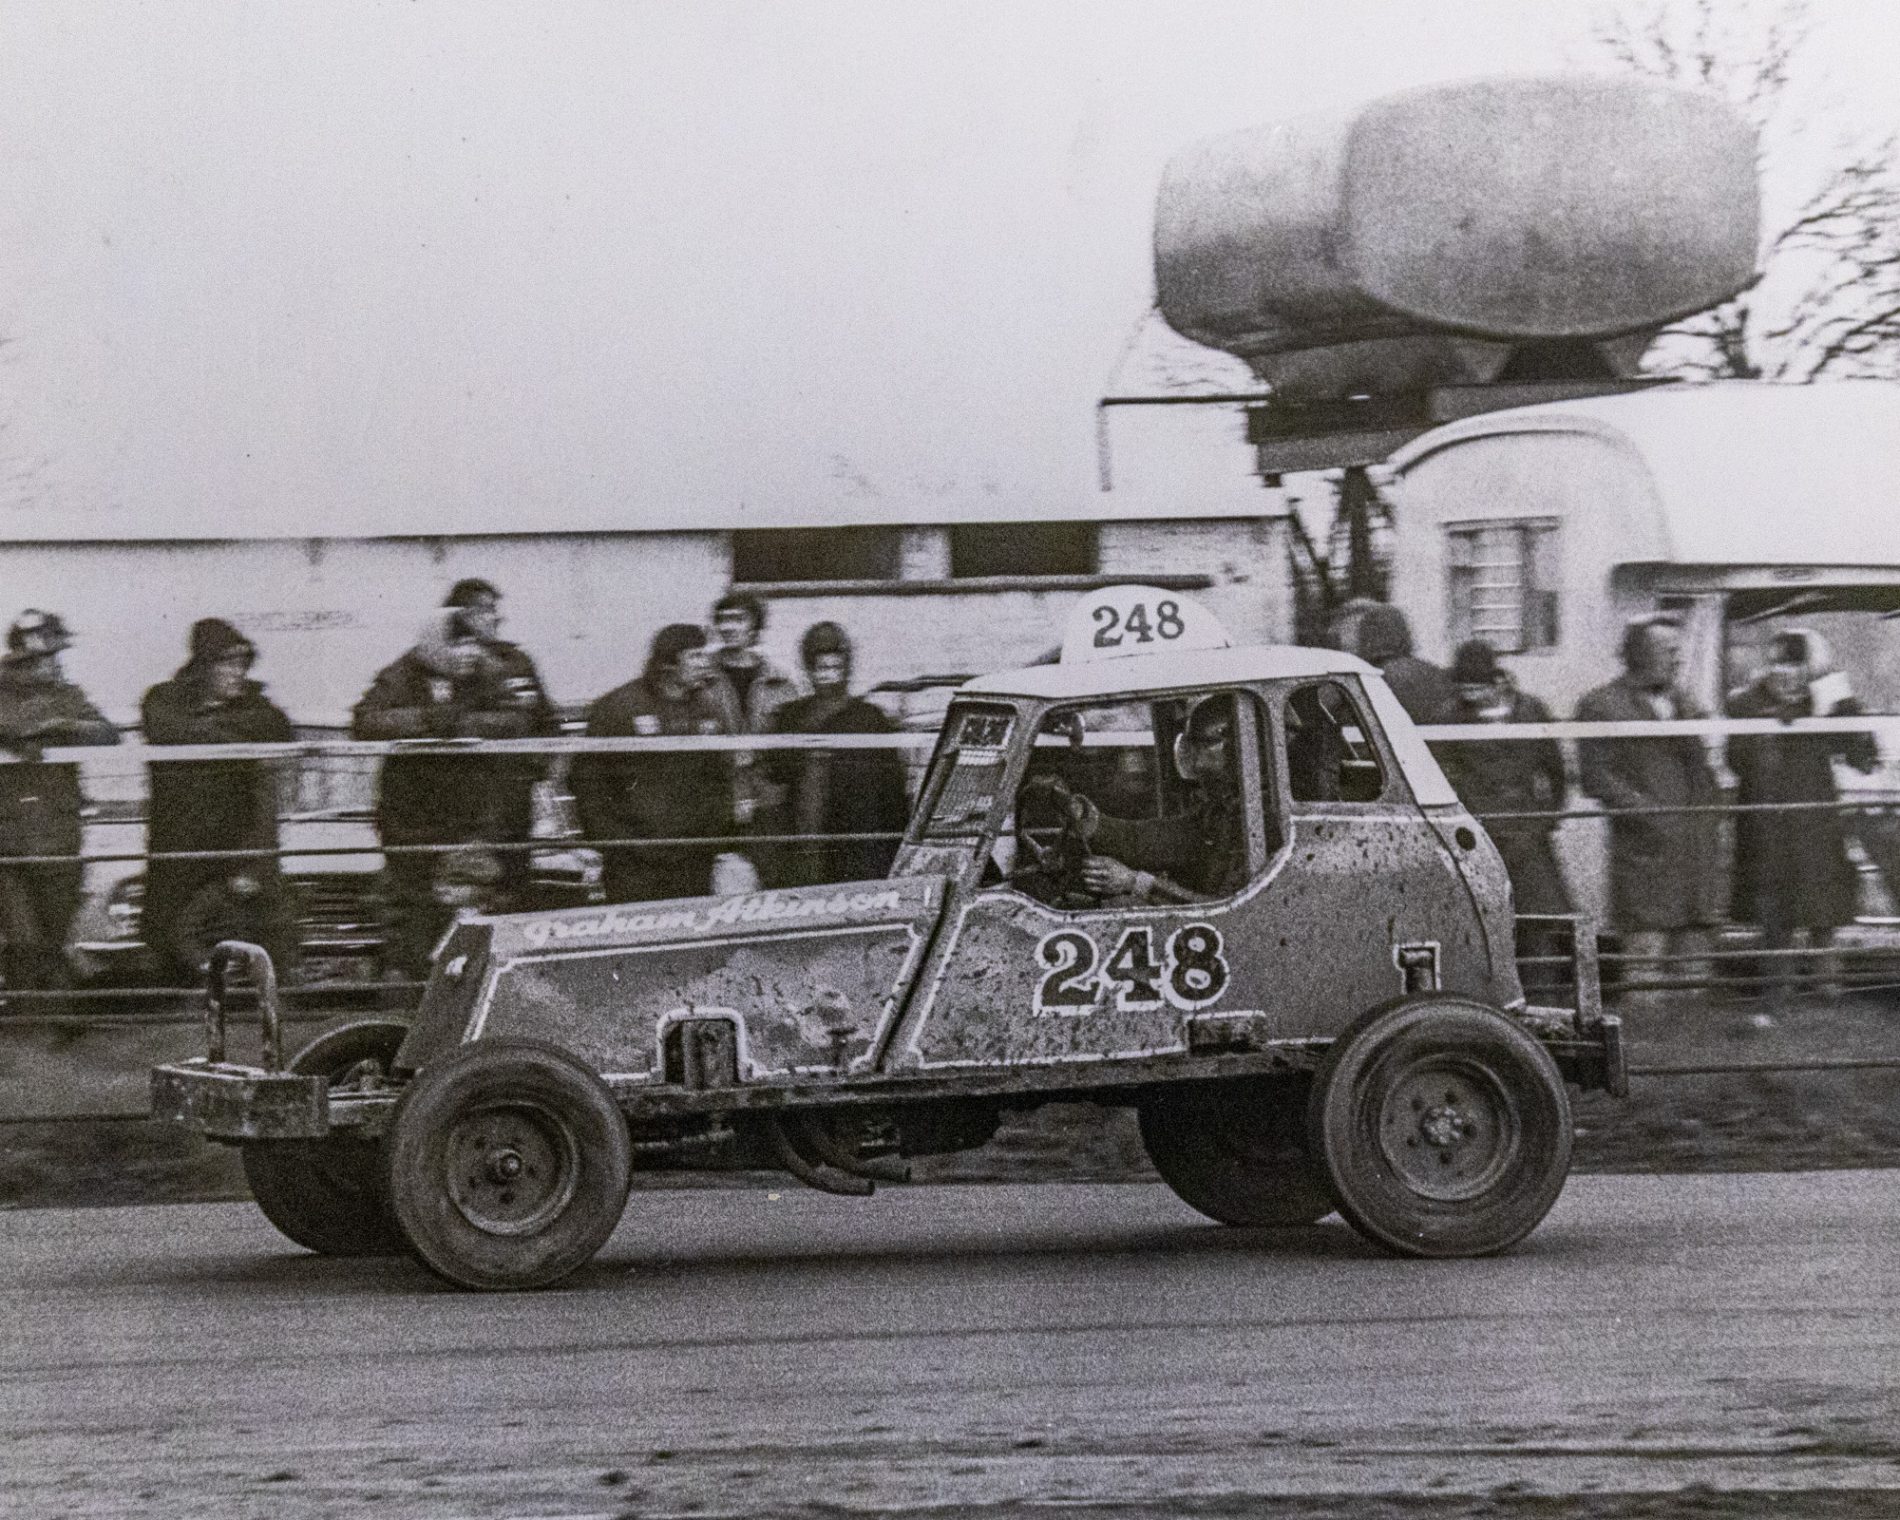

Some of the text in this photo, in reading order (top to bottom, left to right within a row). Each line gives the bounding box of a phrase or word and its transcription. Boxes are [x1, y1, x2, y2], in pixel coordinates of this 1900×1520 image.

[1092, 601, 1185, 648] 248
[524, 889, 901, 946] Graham Atkinson
[1035, 924, 1228, 1015] 248
